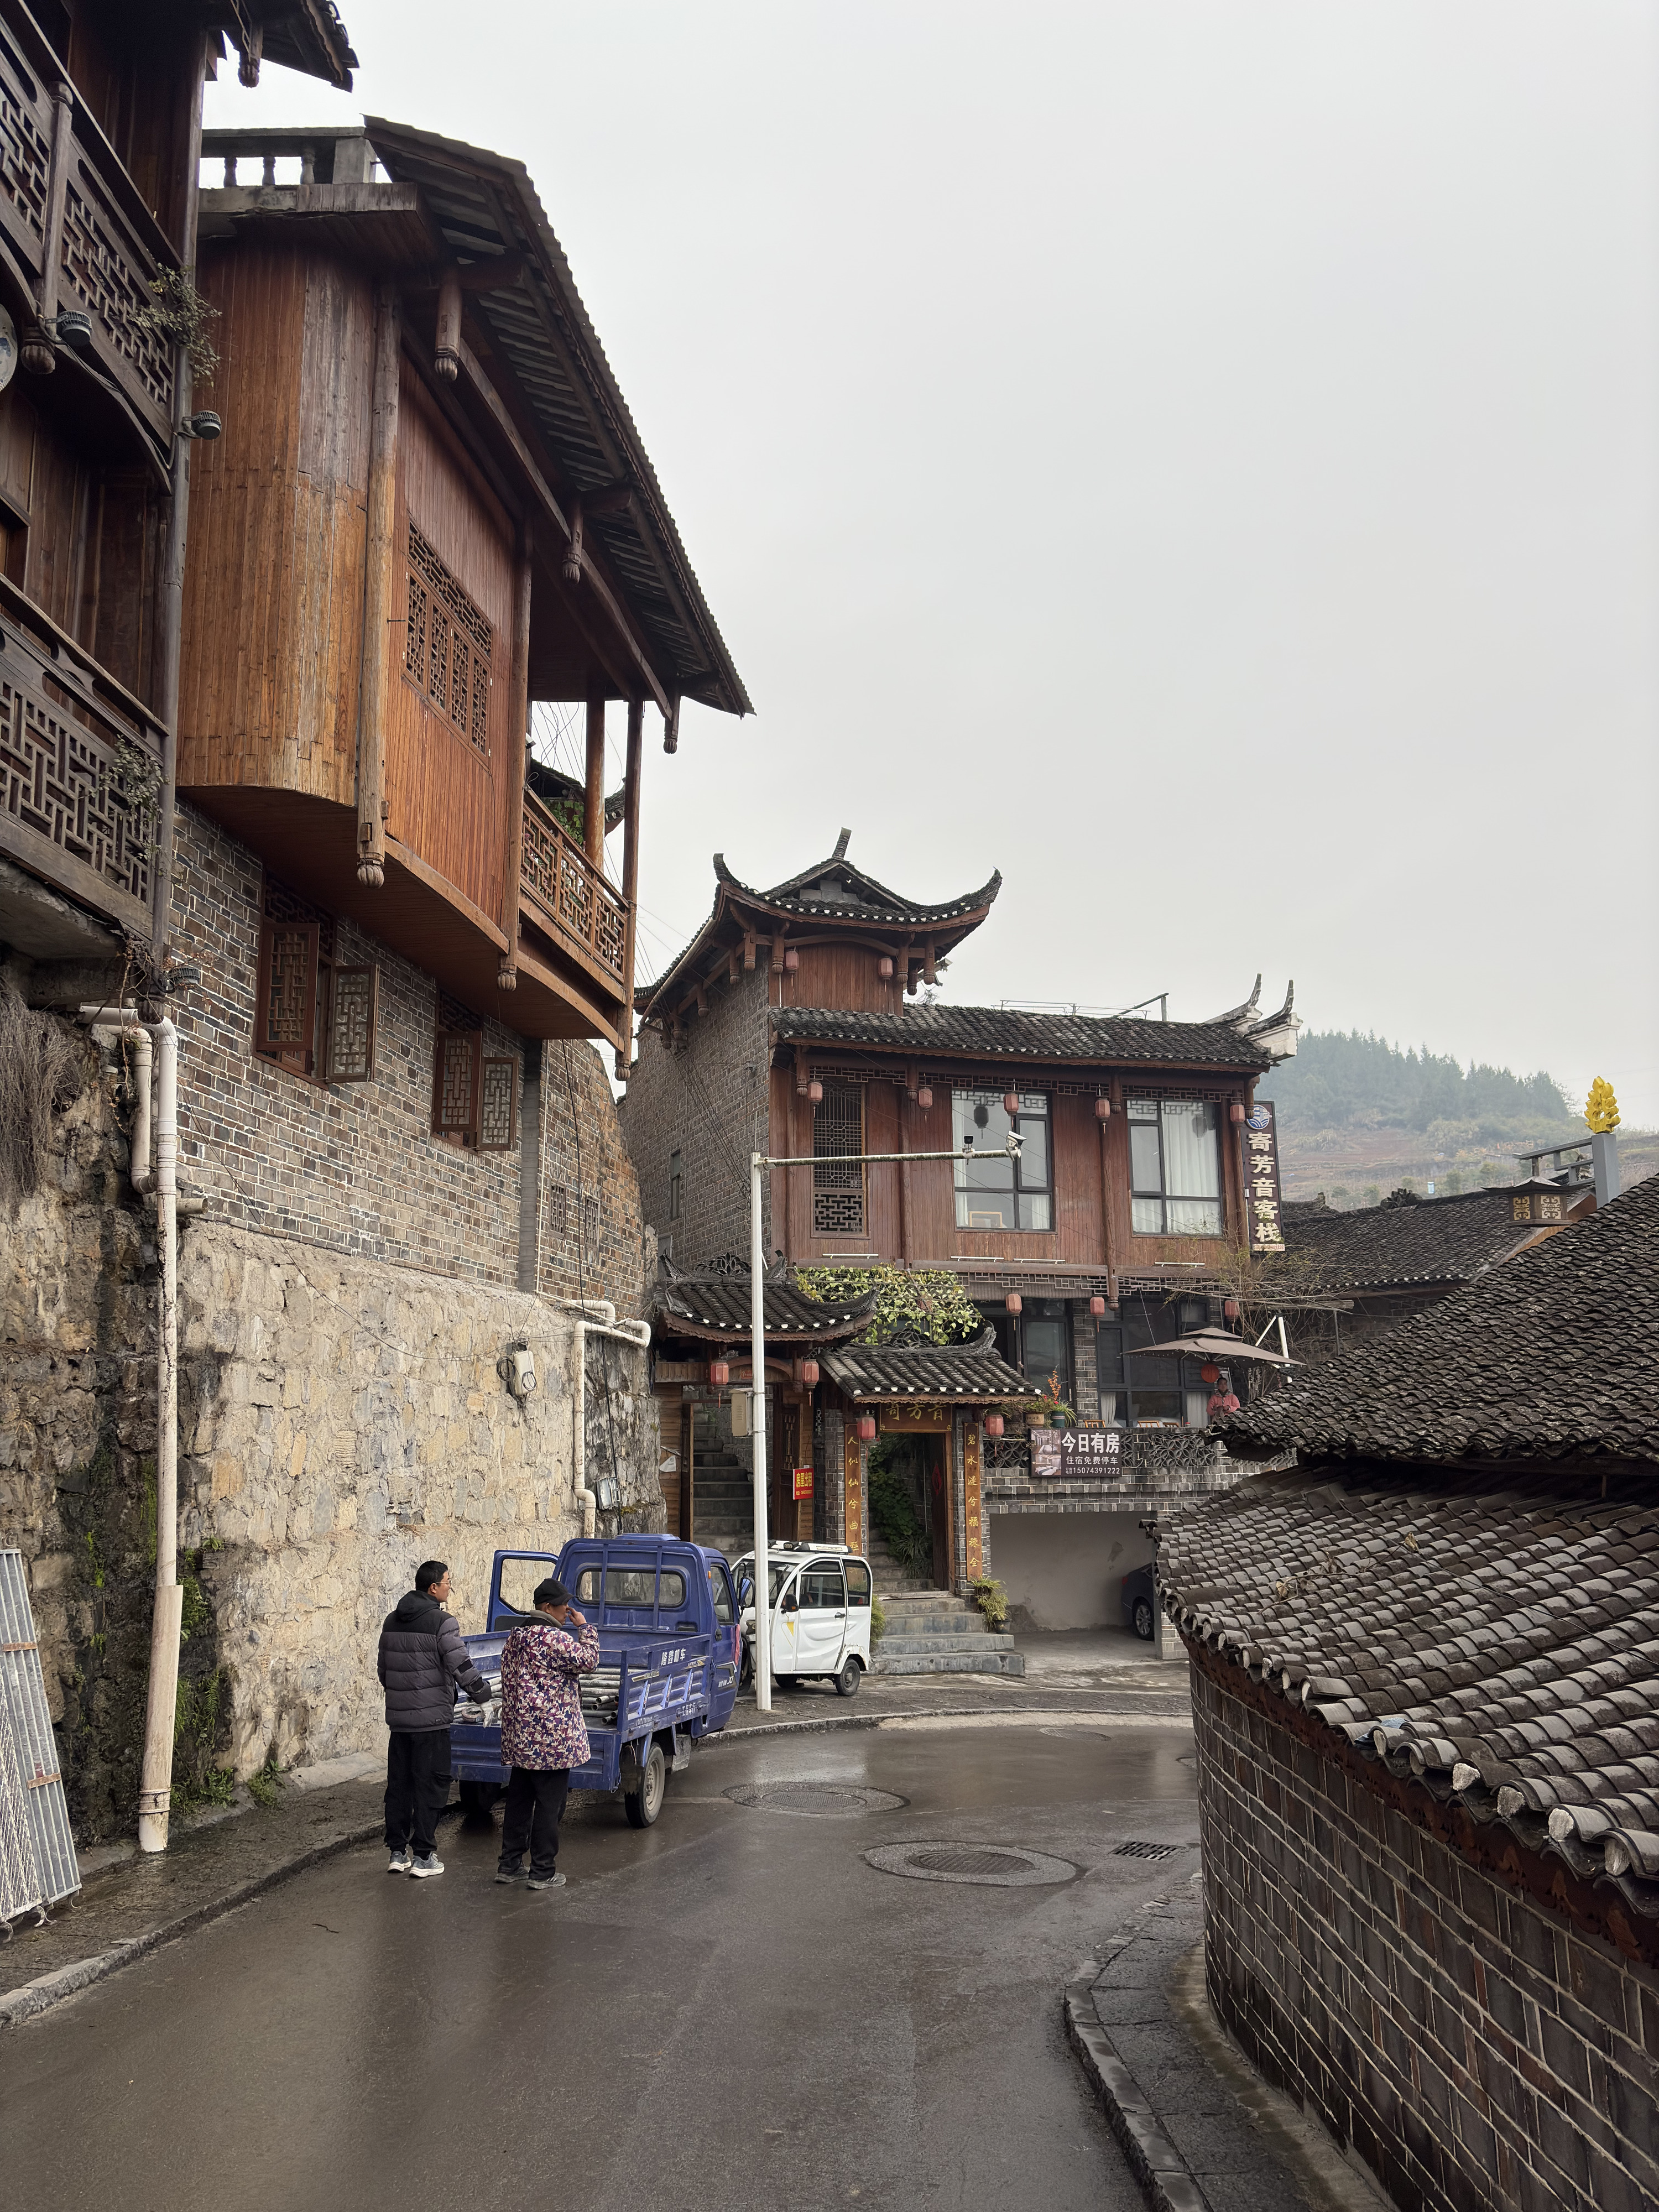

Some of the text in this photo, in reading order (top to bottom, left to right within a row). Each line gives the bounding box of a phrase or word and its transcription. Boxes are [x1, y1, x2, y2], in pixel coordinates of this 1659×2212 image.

[1249, 1132, 1281, 1242] 寄芳音客栈
[1061, 1432, 1120, 1453] 今日有房
[1066, 1456, 1118, 1465] 住宿免费停车
[796, 1472, 812, 1488] 房屋出租
[661, 1647, 686, 1666] 隆鑫机车
